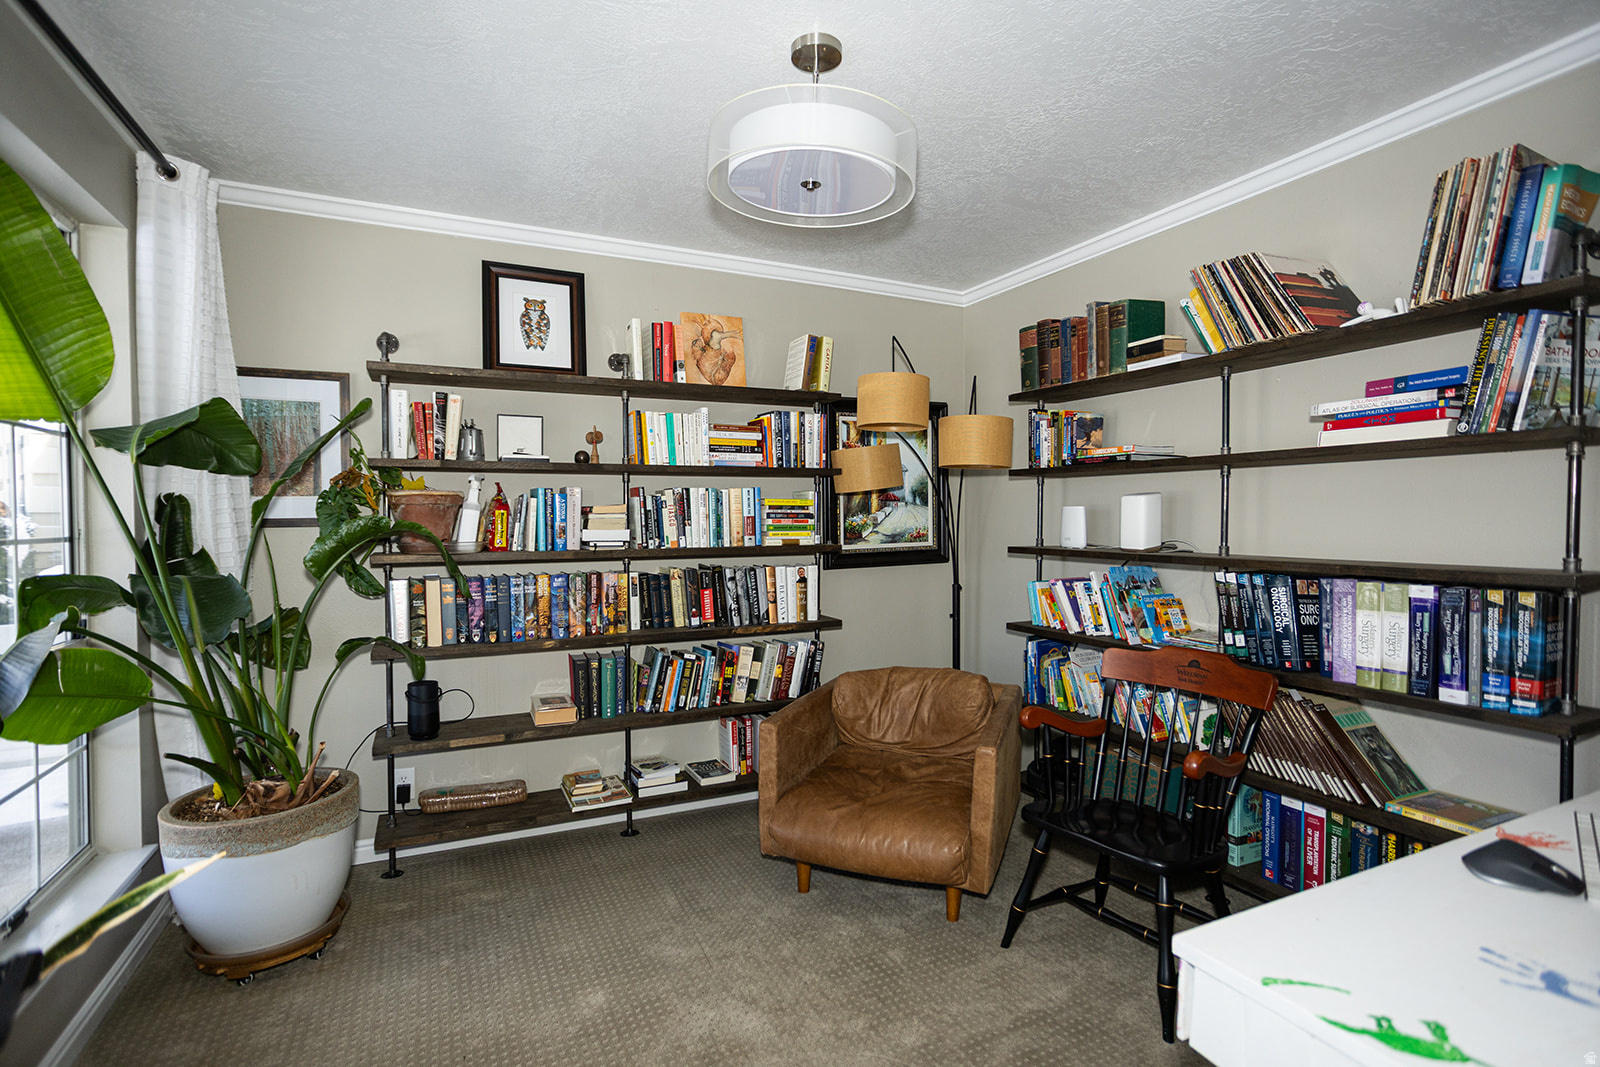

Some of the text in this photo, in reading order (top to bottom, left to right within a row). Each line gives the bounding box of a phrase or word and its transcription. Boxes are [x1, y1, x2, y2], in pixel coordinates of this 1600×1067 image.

[1509, 181, 1533, 261] HEALTH POLICY ISSUES
[1497, 320, 1507, 337] PRETTY
[1503, 326, 1513, 349] ORGANIC
[1508, 329, 1521, 358] KITCHEN
[1467, 318, 1496, 405] DRESSING THE MAN
[1494, 365, 1502, 380] CARE
[1322, 406, 1339, 414] ATLAS
[1350, 402, 1379, 411] SURGICAL
[1380, 397, 1422, 407] OPERATIONS
[667, 504, 676, 527] FIASCO
[703, 590, 711, 619] WASHINGTON
[1270, 587, 1283, 634] ONCOLOGY
[1278, 586, 1290, 627] SURGICAL
[1444, 609, 1452, 623] Liver,
[1300, 616, 1319, 626] ONC
[1359, 619, 1371, 657] Surgery
[1385, 621, 1399, 660] Surgery
[1421, 663, 1429, 676] Liver,
